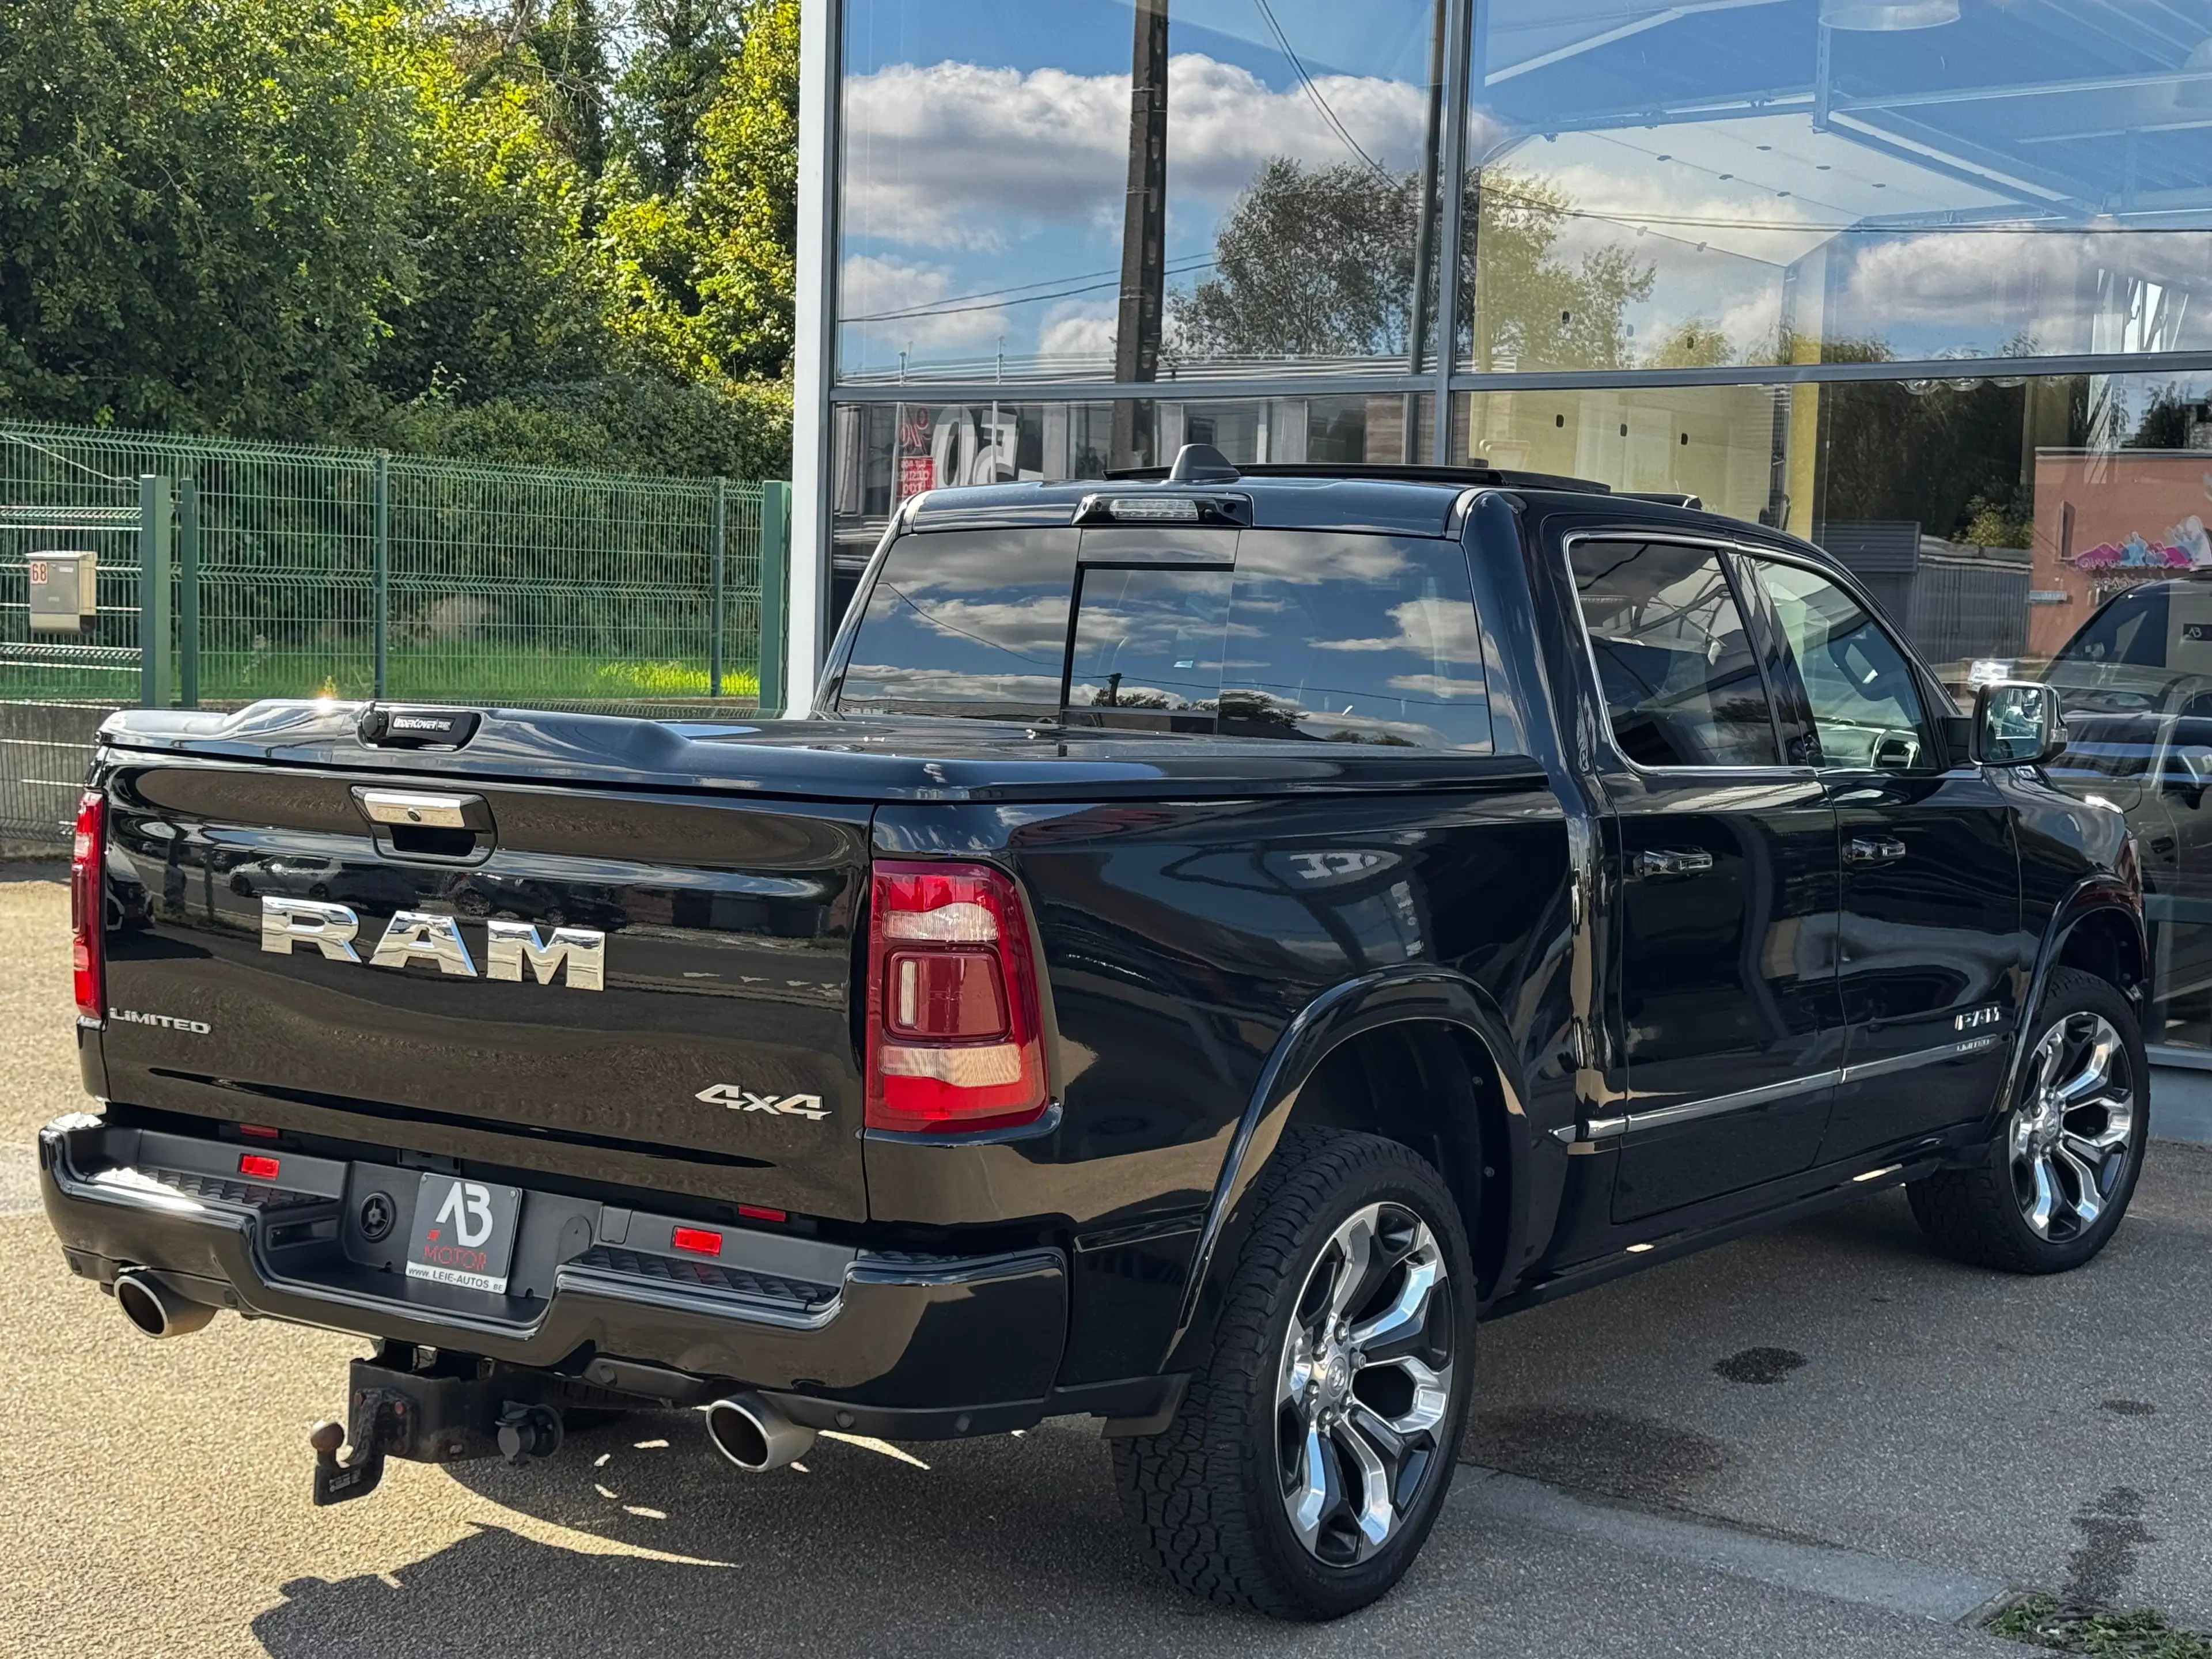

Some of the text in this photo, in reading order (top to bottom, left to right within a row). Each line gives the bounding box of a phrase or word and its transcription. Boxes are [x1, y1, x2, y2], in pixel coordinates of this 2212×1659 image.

[32, 563, 46, 581] 68
[261, 895, 606, 991] RAM
[109, 1007, 212, 1035] LIMITED
[435, 1181, 493, 1248] AB
[423, 1244, 487, 1271] MOTOR
